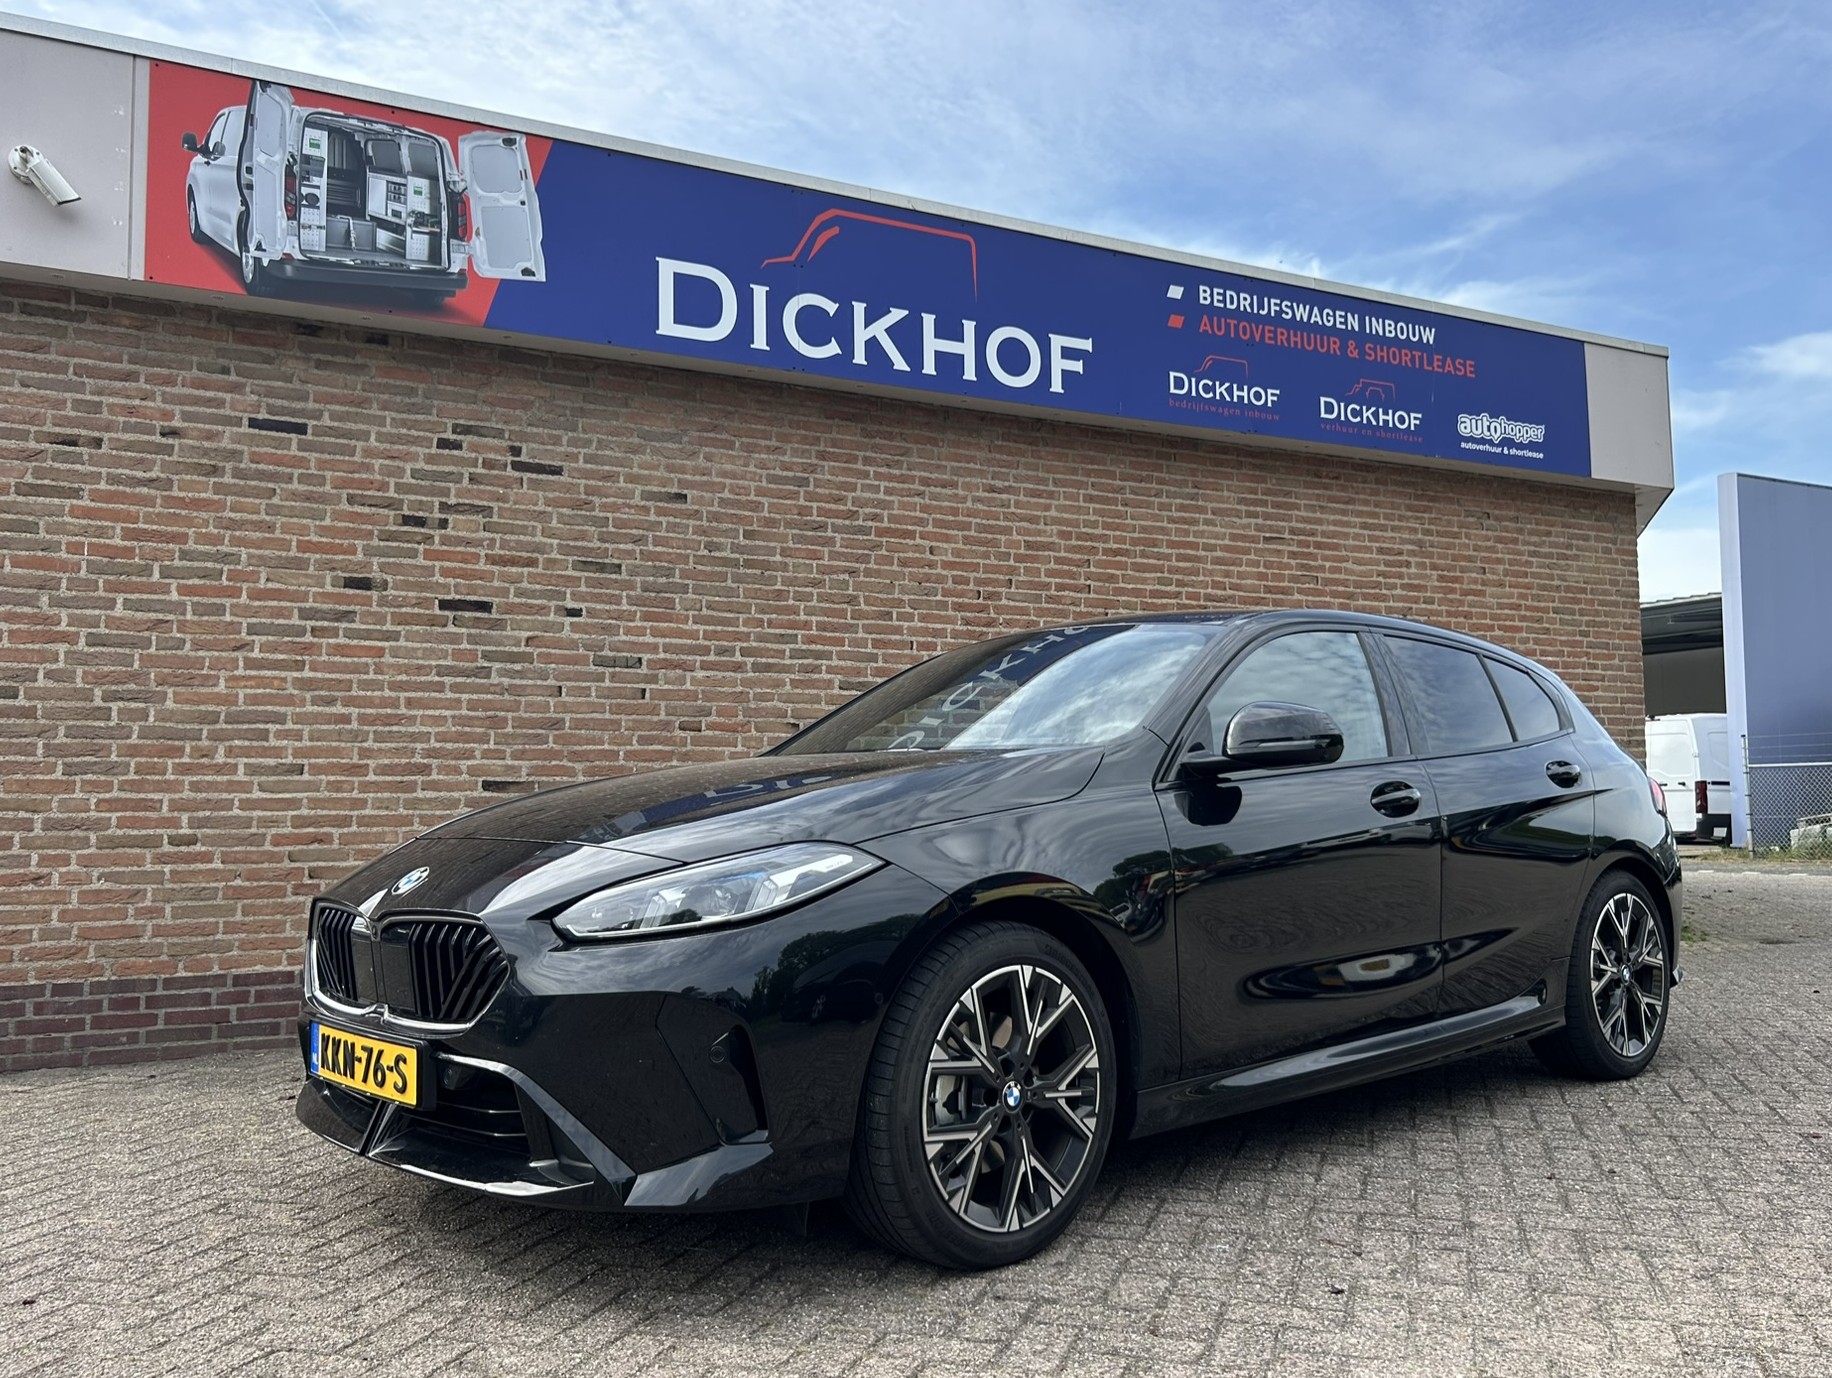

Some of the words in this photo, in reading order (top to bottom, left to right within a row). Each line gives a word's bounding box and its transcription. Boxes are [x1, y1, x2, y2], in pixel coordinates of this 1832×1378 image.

[655, 256, 1093, 394] DICKHOF
[1199, 285, 1359, 332] BEDRIJFSWAGEN
[1365, 316, 1436, 345] INBOUW
[1199, 314, 1341, 356] AUTOVERHUUR
[1347, 340, 1360, 359] &
[1365, 343, 1476, 378] SHORTLEASE
[1168, 370, 1281, 408] DICKHOF
[1168, 398, 1241, 416] bedrijfswagen
[1244, 408, 1281, 421] inbouw
[1319, 396, 1423, 431] DICKHOF
[1320, 422, 1359, 434] verhuur
[1361, 428, 1373, 437] en
[1376, 429, 1424, 443] shortlease
[1458, 413, 1545, 443] autohopper
[1460, 441, 1502, 454] autoverhuur
[1503, 446, 1509, 455] &
[1509, 447, 1544, 459] shortlease
[320, 1032, 408, 1095] KKN-76-S
